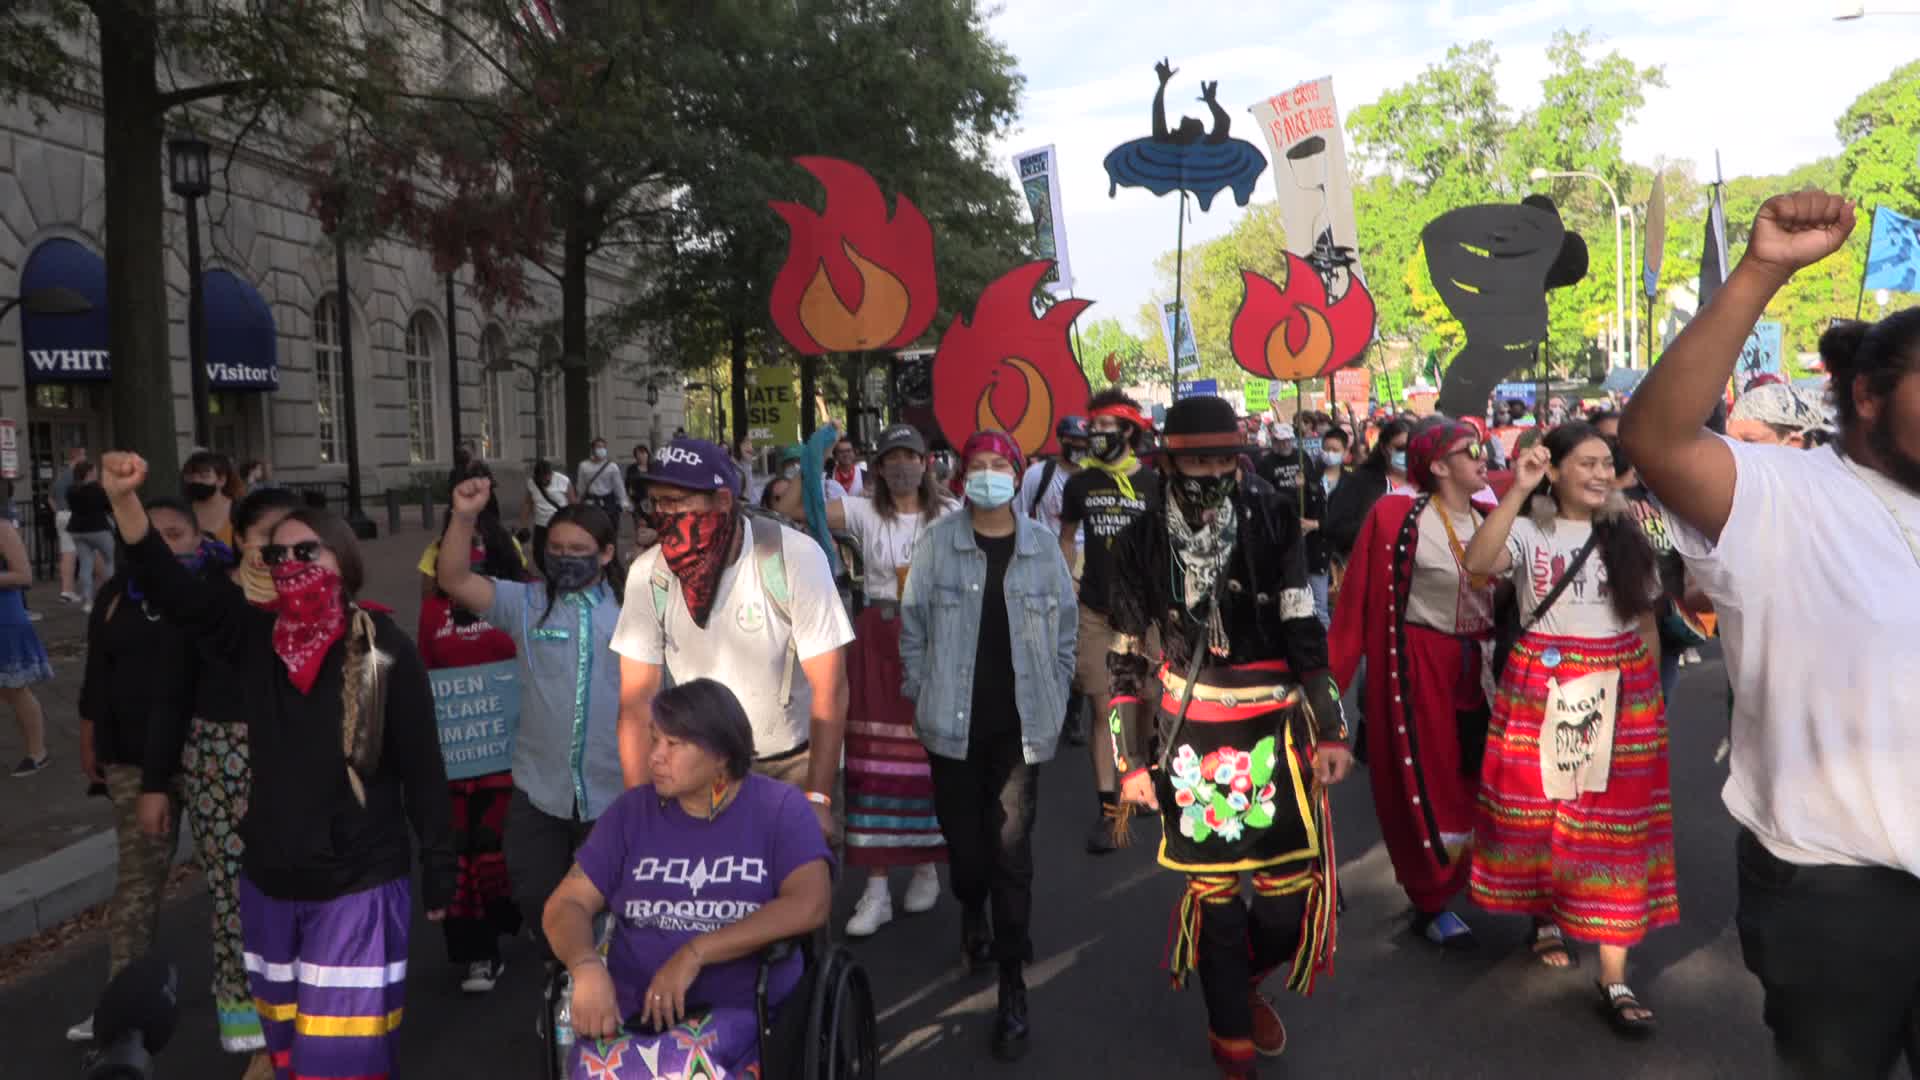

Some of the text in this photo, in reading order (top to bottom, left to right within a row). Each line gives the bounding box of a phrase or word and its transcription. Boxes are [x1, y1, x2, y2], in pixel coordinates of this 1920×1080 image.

[28, 349, 112, 371] WHIT
[206, 363, 268, 381] Visitor
[749, 386, 790, 403] ATE
